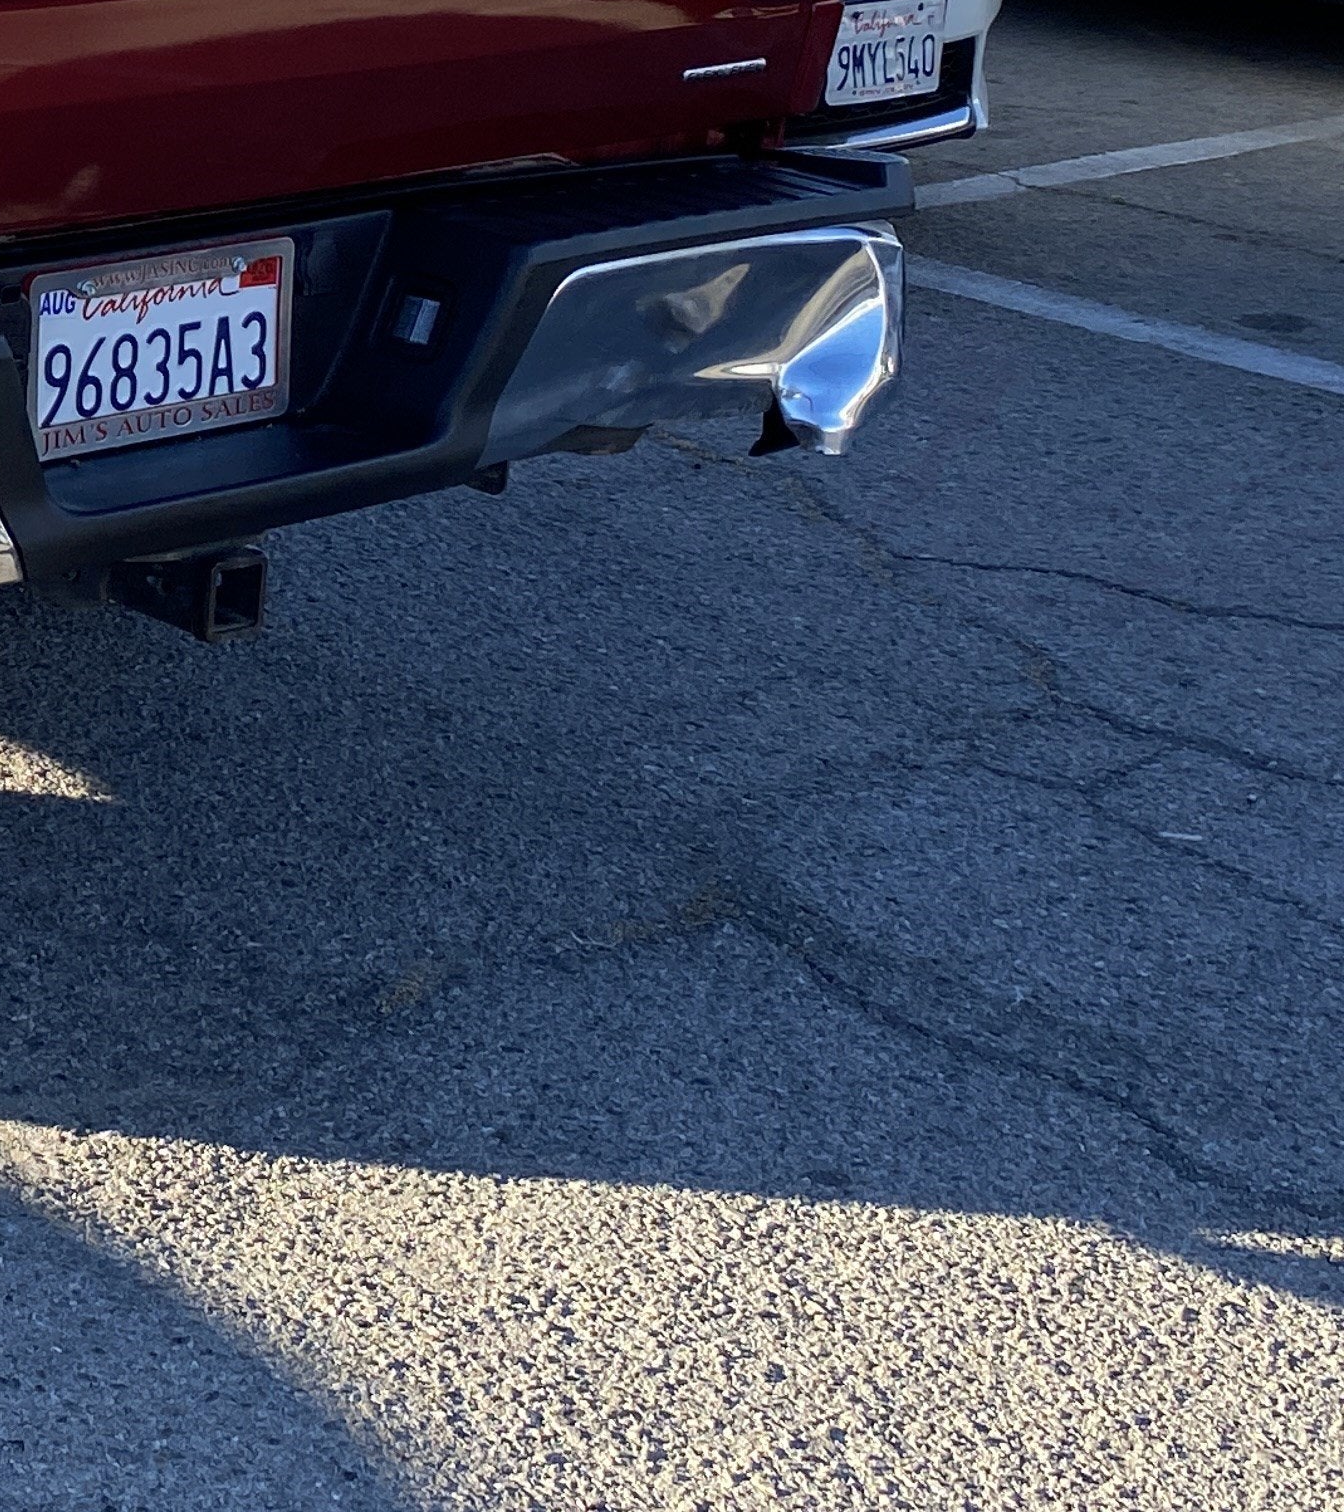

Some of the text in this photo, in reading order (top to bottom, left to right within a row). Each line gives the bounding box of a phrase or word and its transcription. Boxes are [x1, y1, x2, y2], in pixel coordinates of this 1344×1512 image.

[836, 33, 935, 91] 9MYL540
[40, 276, 241, 325] AUG California
[39, 310, 268, 430] 96835A3
[42, 390, 275, 456] JIM'S AUTO SALES
